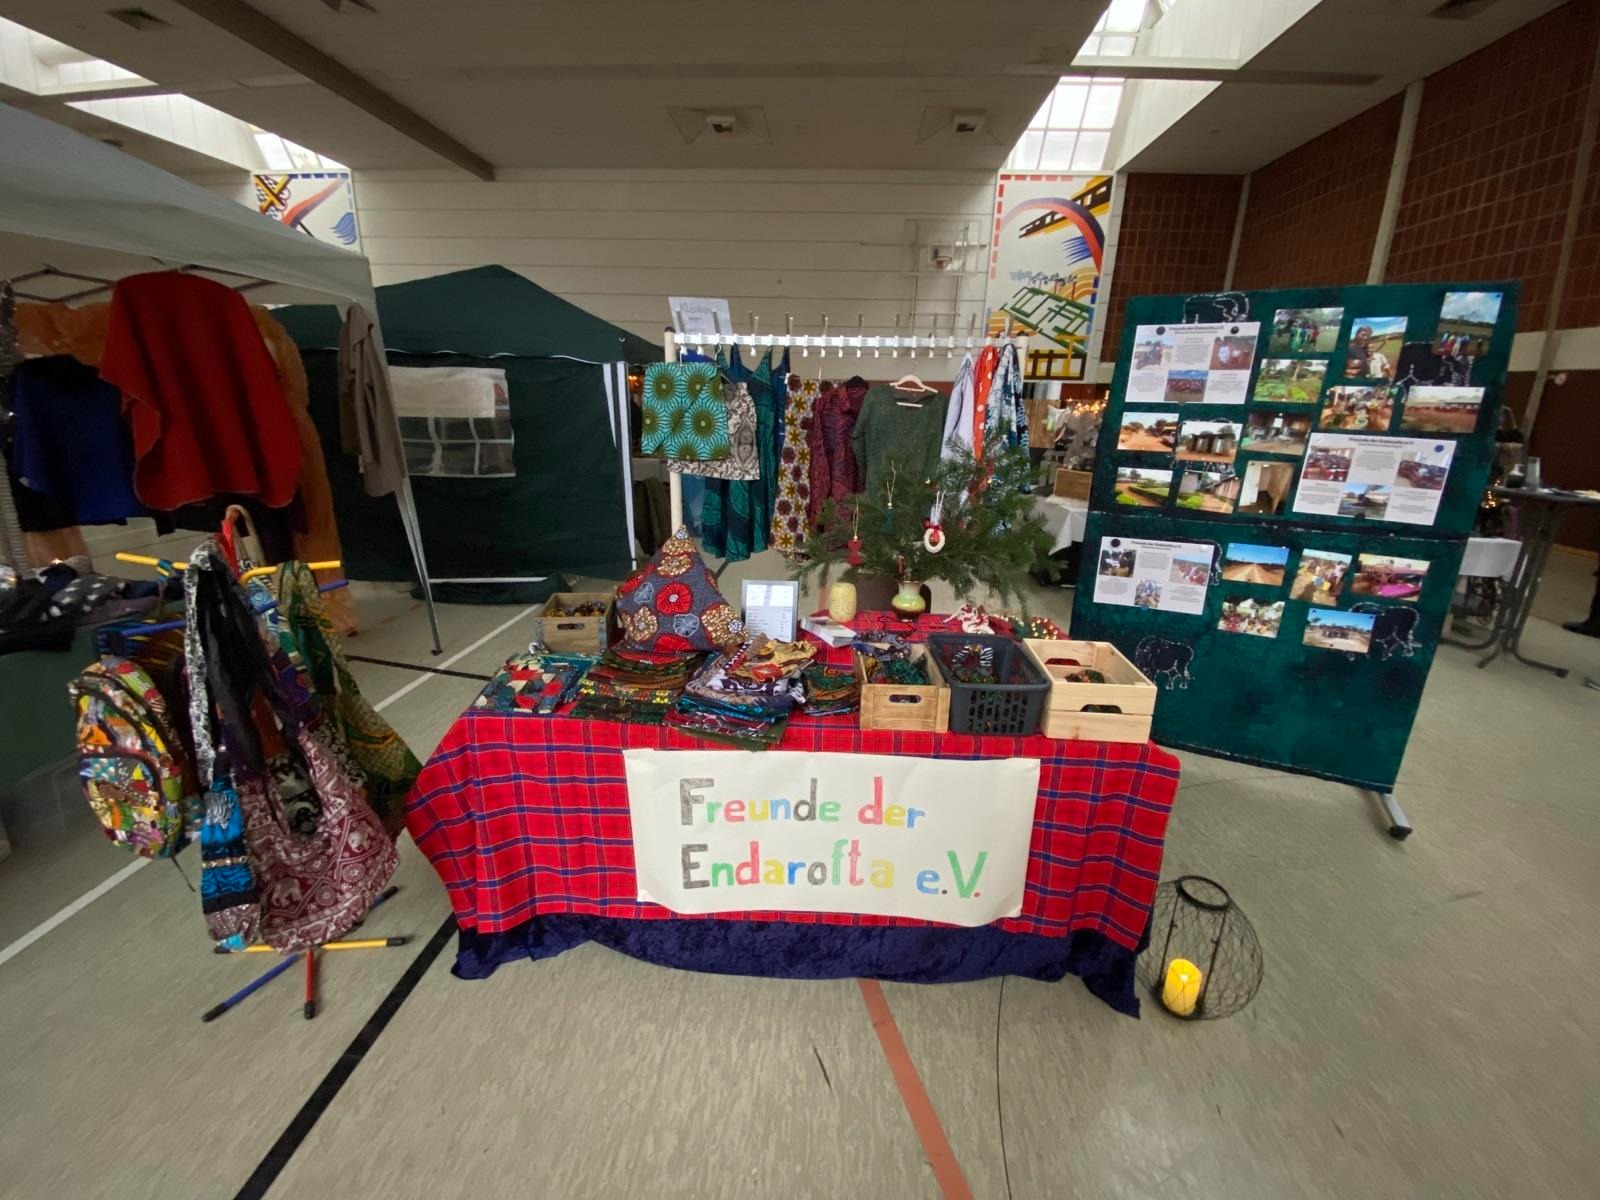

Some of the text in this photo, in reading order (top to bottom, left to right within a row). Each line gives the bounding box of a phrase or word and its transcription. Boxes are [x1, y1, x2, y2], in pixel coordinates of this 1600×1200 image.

[679, 776, 926, 829] Freunde der
[681, 839, 988, 898] Endarofta e.V.
